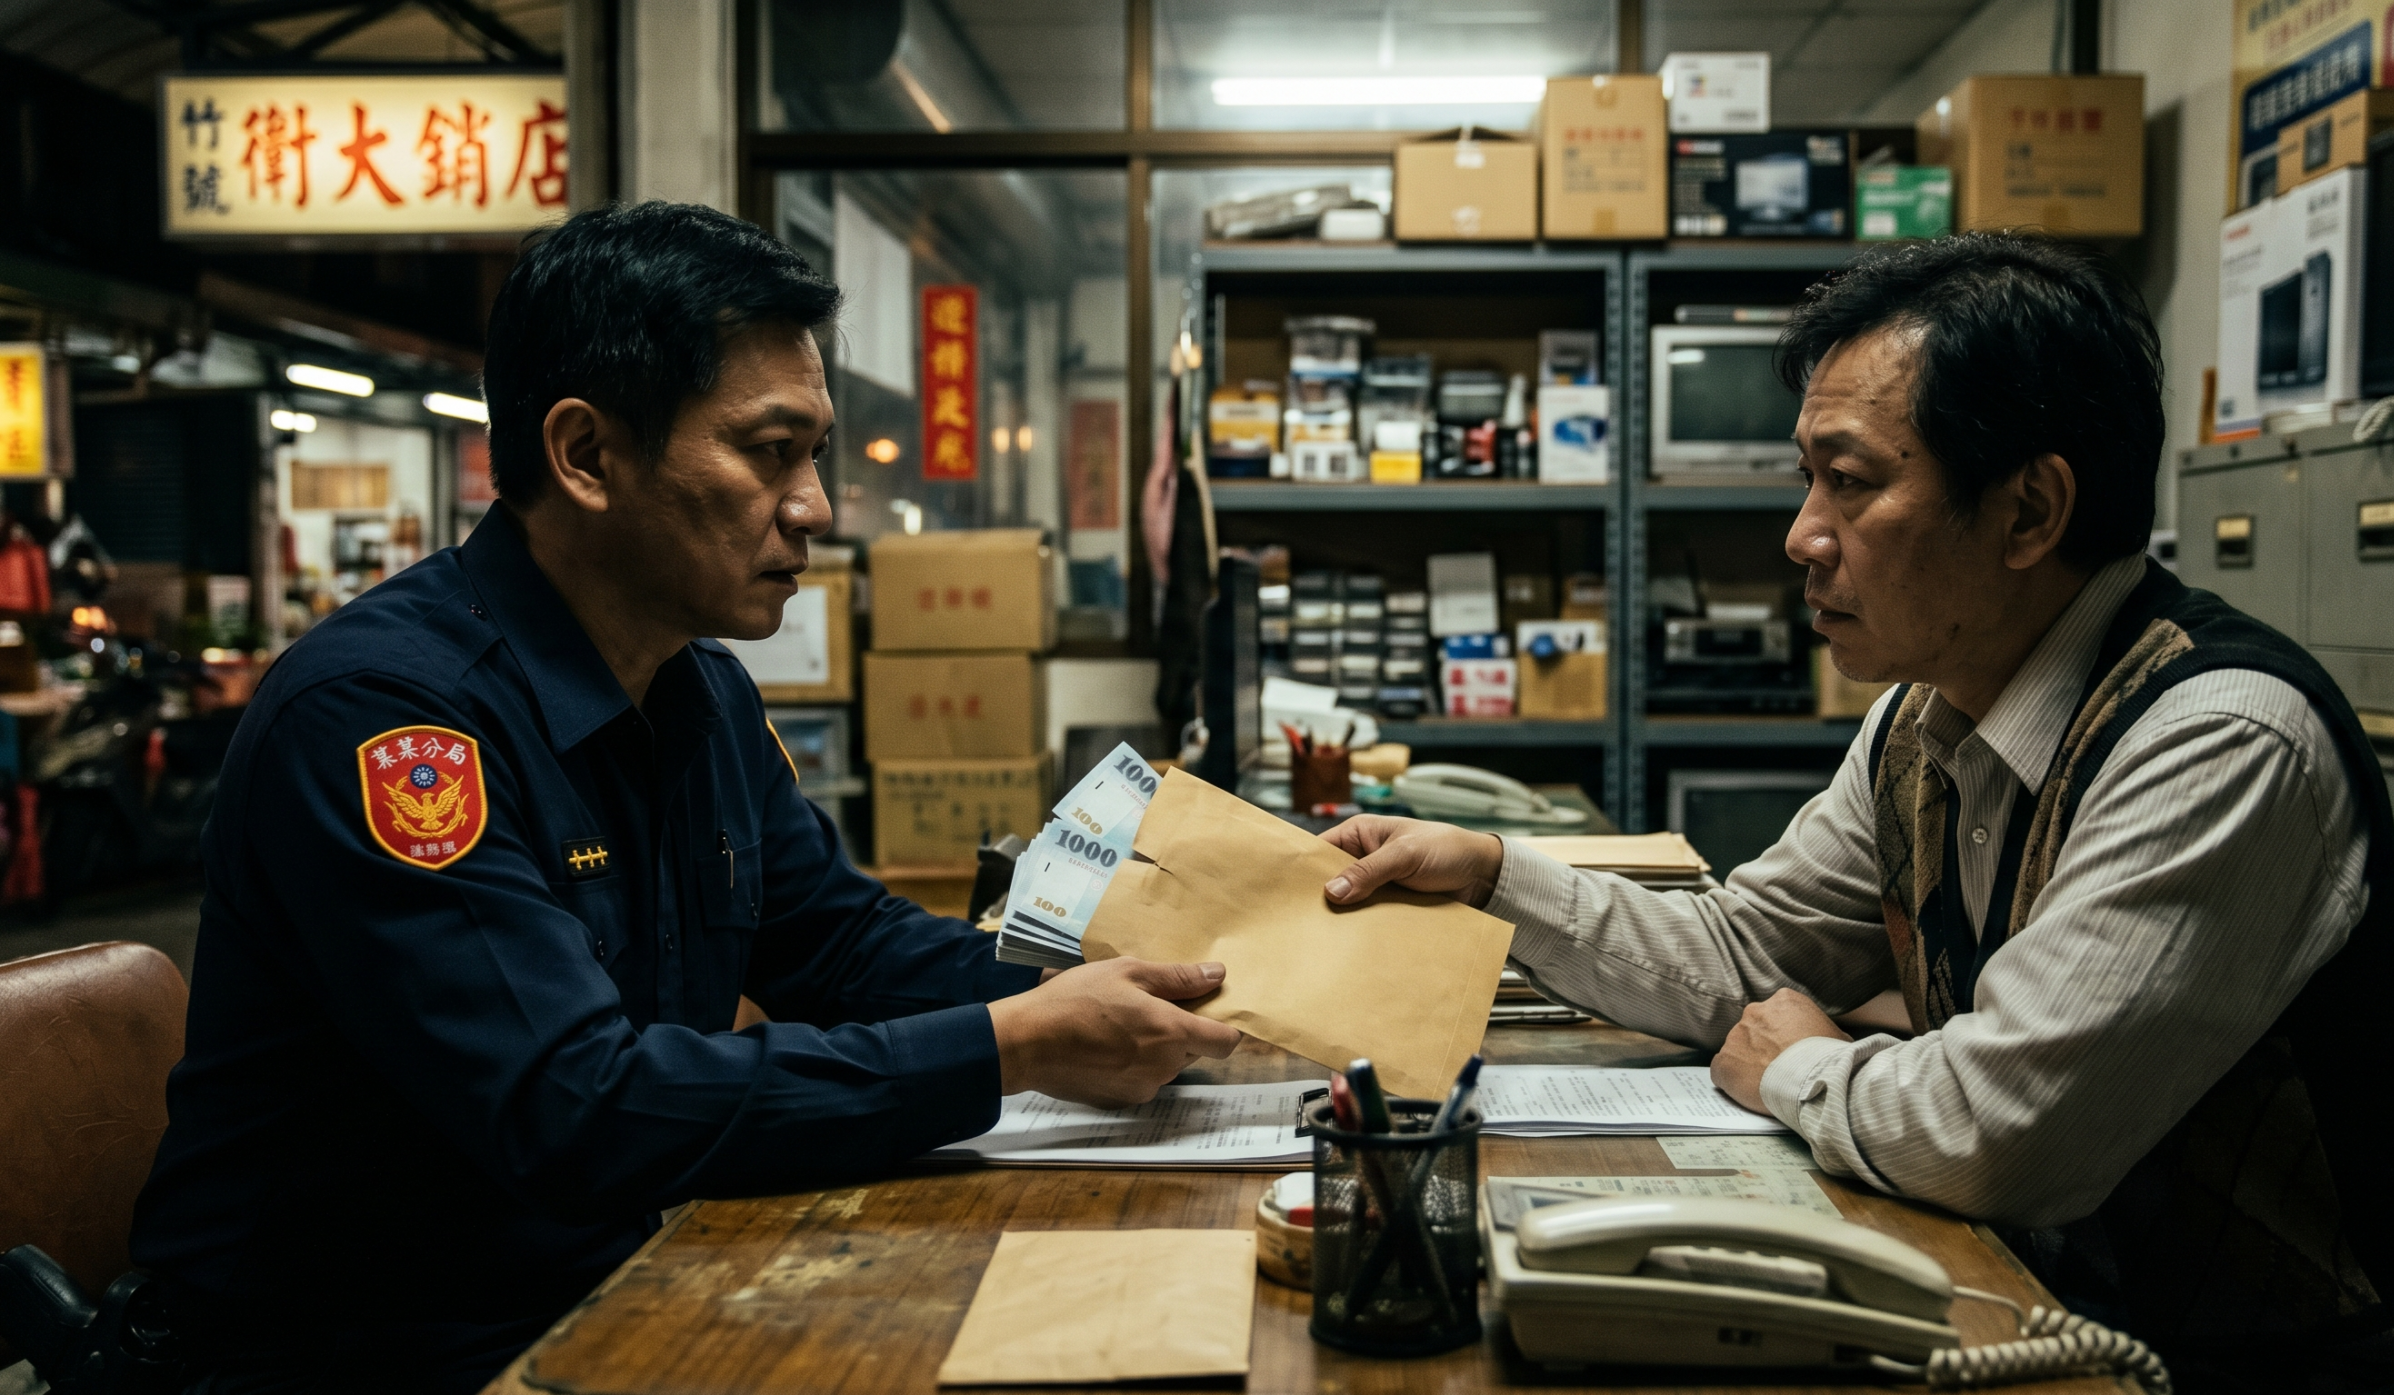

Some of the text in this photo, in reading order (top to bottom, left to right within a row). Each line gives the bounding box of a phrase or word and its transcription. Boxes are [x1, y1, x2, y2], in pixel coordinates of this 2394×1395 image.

[371, 736, 467, 770] 某某分局
[1113, 754, 1156, 799] 100
[1071, 807, 1103, 835] 100
[1055, 829, 1118, 868] 1000
[1033, 896, 1067, 918] 100
